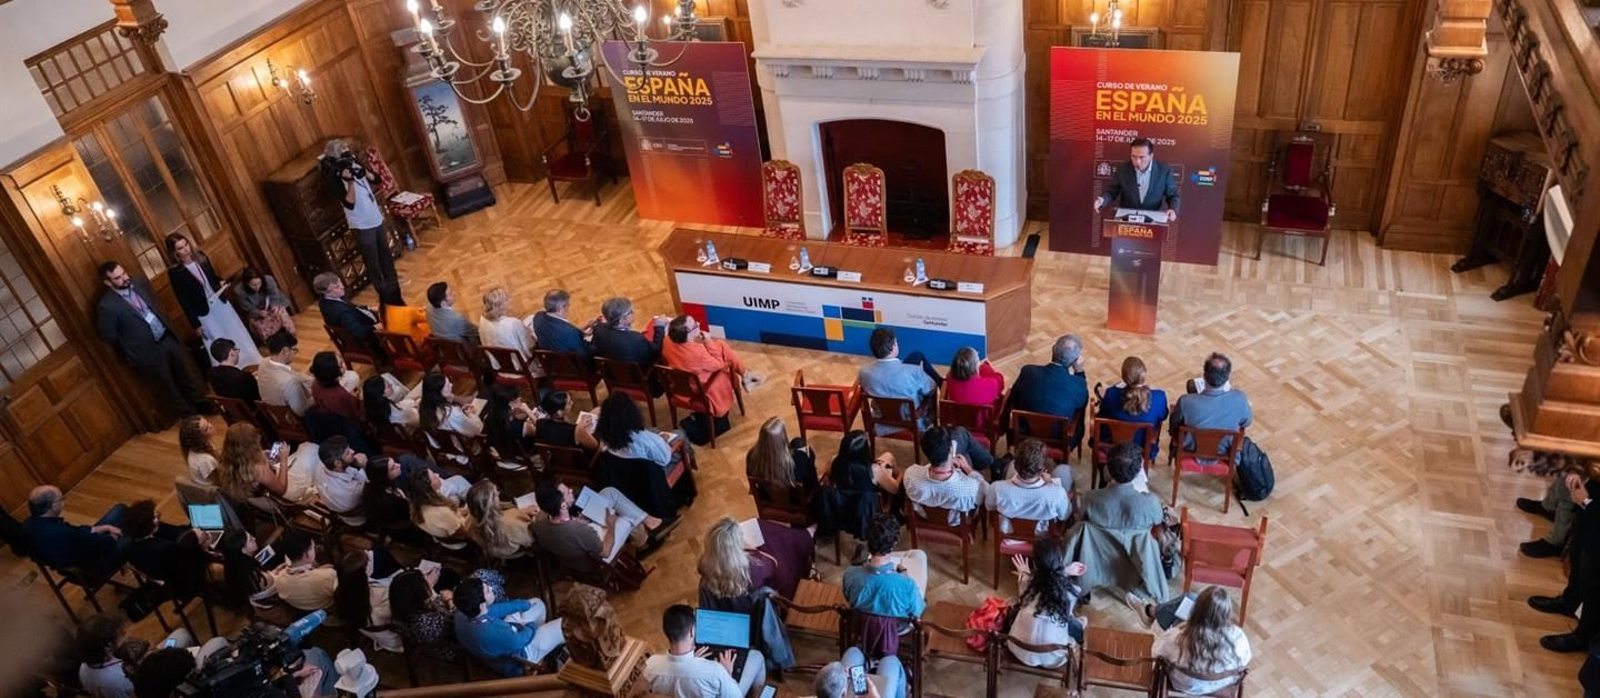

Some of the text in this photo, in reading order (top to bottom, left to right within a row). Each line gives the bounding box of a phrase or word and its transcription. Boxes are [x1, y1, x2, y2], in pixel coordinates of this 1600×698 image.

[624, 72, 711, 96] ESPAÑA
[1136, 83, 1168, 91] VERANO
[628, 94, 713, 106] EN EL MUNDO 2025
[1096, 87, 1207, 114] ESPAÑA
[1096, 111, 1208, 125] EN EL MUNDO 2025
[1096, 129, 1138, 137] SANTANDER
[1114, 135, 1125, 143] DE
[1157, 138, 1176, 146] 2025
[742, 296, 780, 310] UIMP
